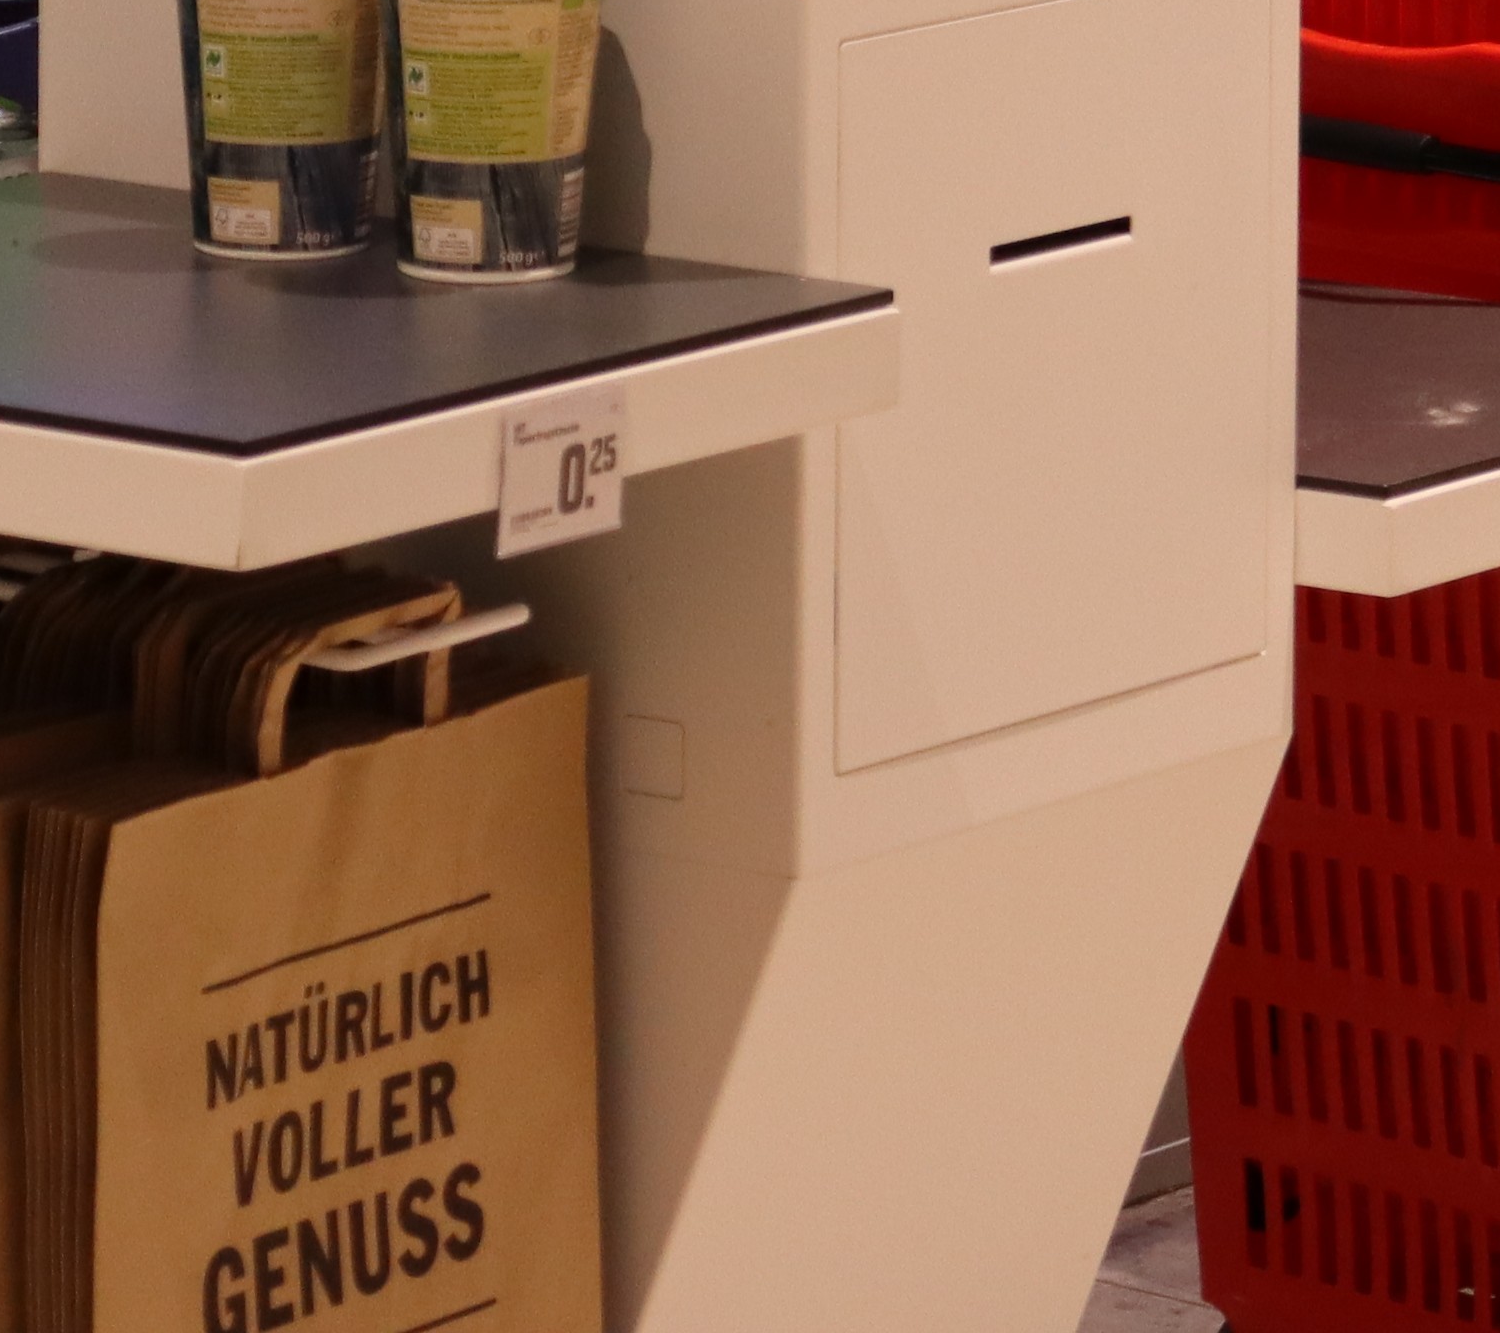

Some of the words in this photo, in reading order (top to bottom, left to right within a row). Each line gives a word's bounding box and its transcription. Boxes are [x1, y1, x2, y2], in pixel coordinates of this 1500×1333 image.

[204, 948, 491, 1112] NATÜRLICH
[231, 1060, 458, 1210] VOLLER
[201, 1162, 488, 1333] GENUSS
